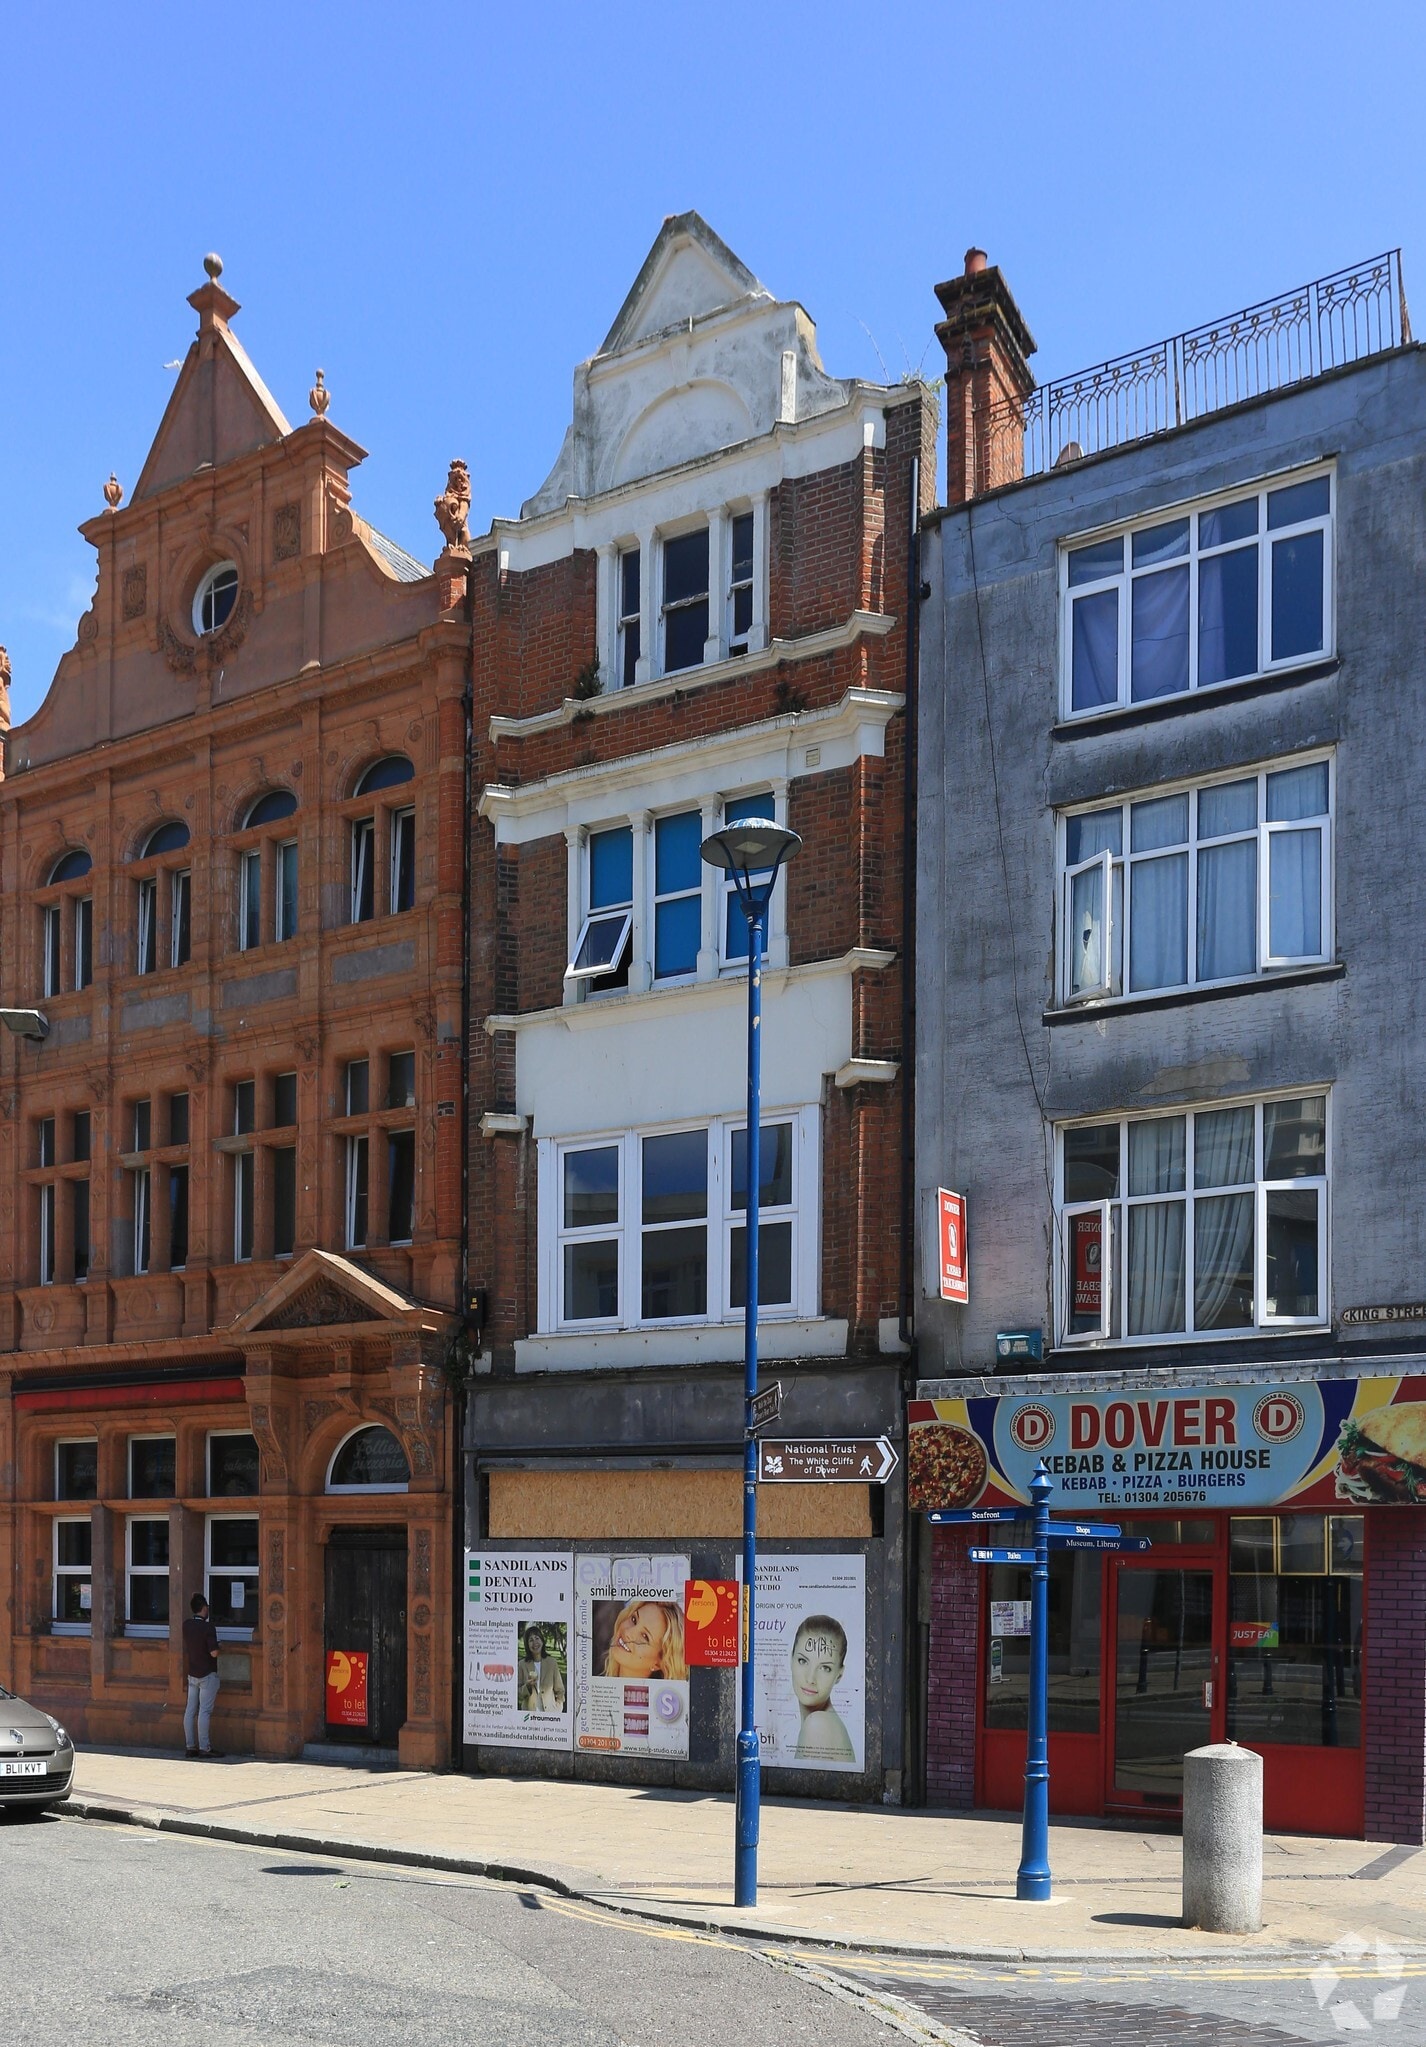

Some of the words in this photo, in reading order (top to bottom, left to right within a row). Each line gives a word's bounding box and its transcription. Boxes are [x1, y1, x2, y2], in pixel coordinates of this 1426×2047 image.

[1350, 1309, 1379, 1321] KING
[1071, 1398, 1237, 1450] DOVER
[1268, 1404, 1292, 1432] D
[1024, 1415, 1044, 1440] D
[785, 1444, 828, 1454] National
[832, 1444, 857, 1454] Trust
[789, 1457, 804, 1465] The
[806, 1457, 829, 1466] White
[832, 1457, 854, 1466] Cliffs
[1040, 1454, 1104, 1474] KEBAB
[1112, 1453, 1126, 1473] &
[1134, 1452, 1193, 1472] PIZZA
[1201, 1449, 1270, 1470] HOUSE
[804, 1466, 812, 1474] of
[816, 1466, 839, 1474] Dover
[1062, 1477, 1107, 1490] KEBAB
[1122, 1475, 1162, 1489] PIZZA
[1178, 1473, 1246, 1488] BURGERS
[1098, 1492, 1121, 1503] TEL:
[1124, 1492, 1159, 1503] 01304
[1163, 1491, 1206, 1502] 205676
[972, 1511, 1000, 1519] Seafront
[1076, 1526, 1091, 1535] Shops
[1066, 1539, 1095, 1548] Museum,
[1097, 1540, 1121, 1549] Library
[484, 1560, 568, 1571] SANDILANDS
[485, 1576, 536, 1588] DENTAL
[580, 1559, 684, 1596] expert
[590, 1584, 617, 1597] smile
[620, 1585, 674, 1598] makeover
[484, 1592, 533, 1604] STUDIO
[578, 1600, 588, 1625] smile
[754, 1618, 786, 1634] eauty
[1233, 1630, 1256, 1640] JUST
[1257, 1630, 1274, 1639] EAT
[578, 1628, 588, 1658] whiter
[708, 1635, 718, 1648] to
[722, 1635, 736, 1648] let
[578, 1662, 590, 1705] brighter,
[344, 1699, 352, 1709] to
[354, 1699, 365, 1710] let
[662, 1694, 674, 1716] S
[580, 1717, 590, 1732] get
[468, 1731, 568, 1743] www.sandilandsdentalstudio.com
[6, 1764, 22, 1774] BL11
[24, 1763, 42, 1774] KVT
